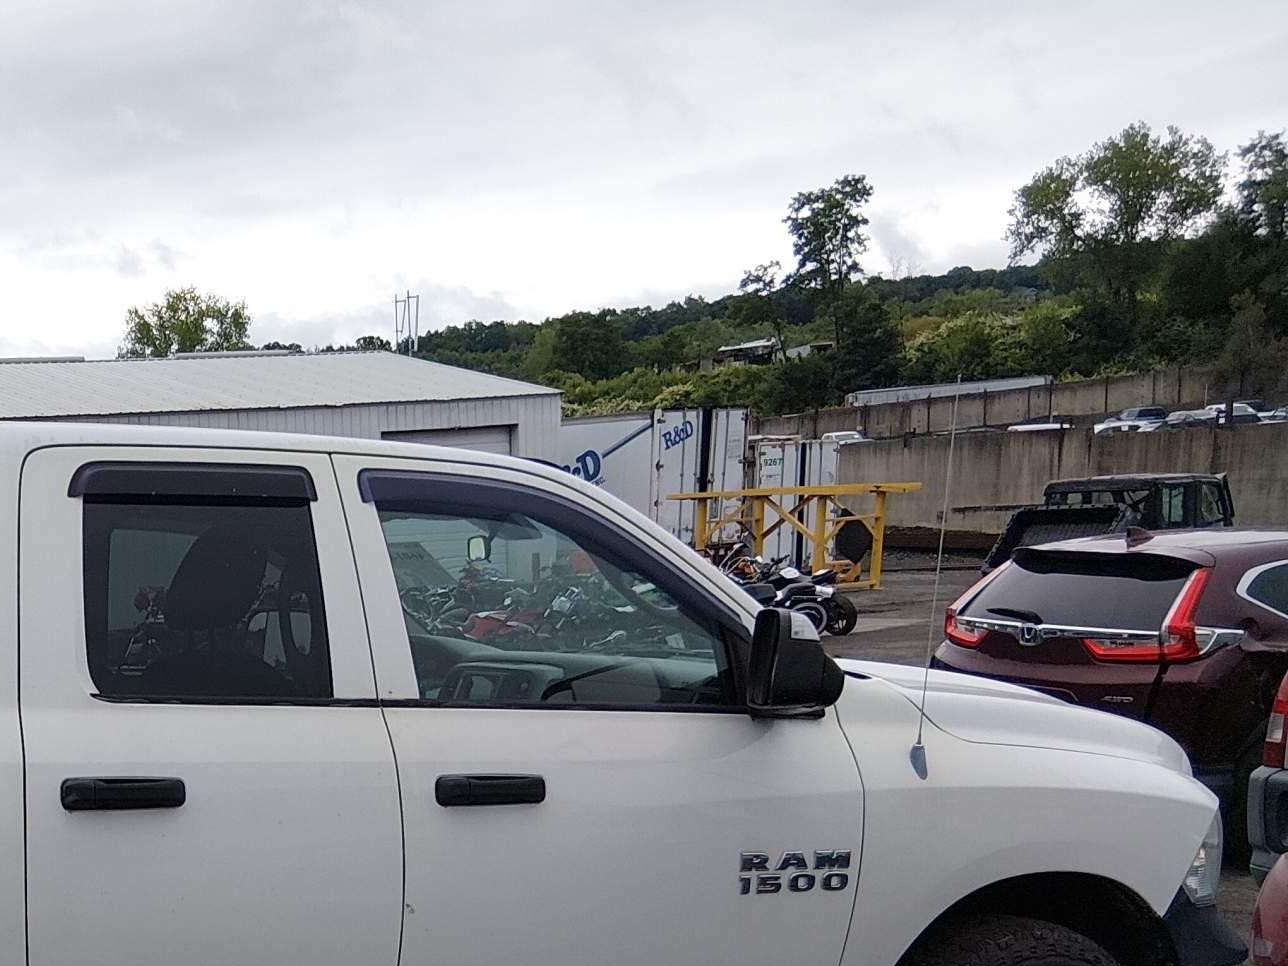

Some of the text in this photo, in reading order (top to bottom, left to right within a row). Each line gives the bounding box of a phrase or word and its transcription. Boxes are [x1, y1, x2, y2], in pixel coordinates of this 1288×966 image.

[662, 420, 693, 450] R&D
[740, 850, 851, 872] RAM
[739, 872, 849, 895] 1500
